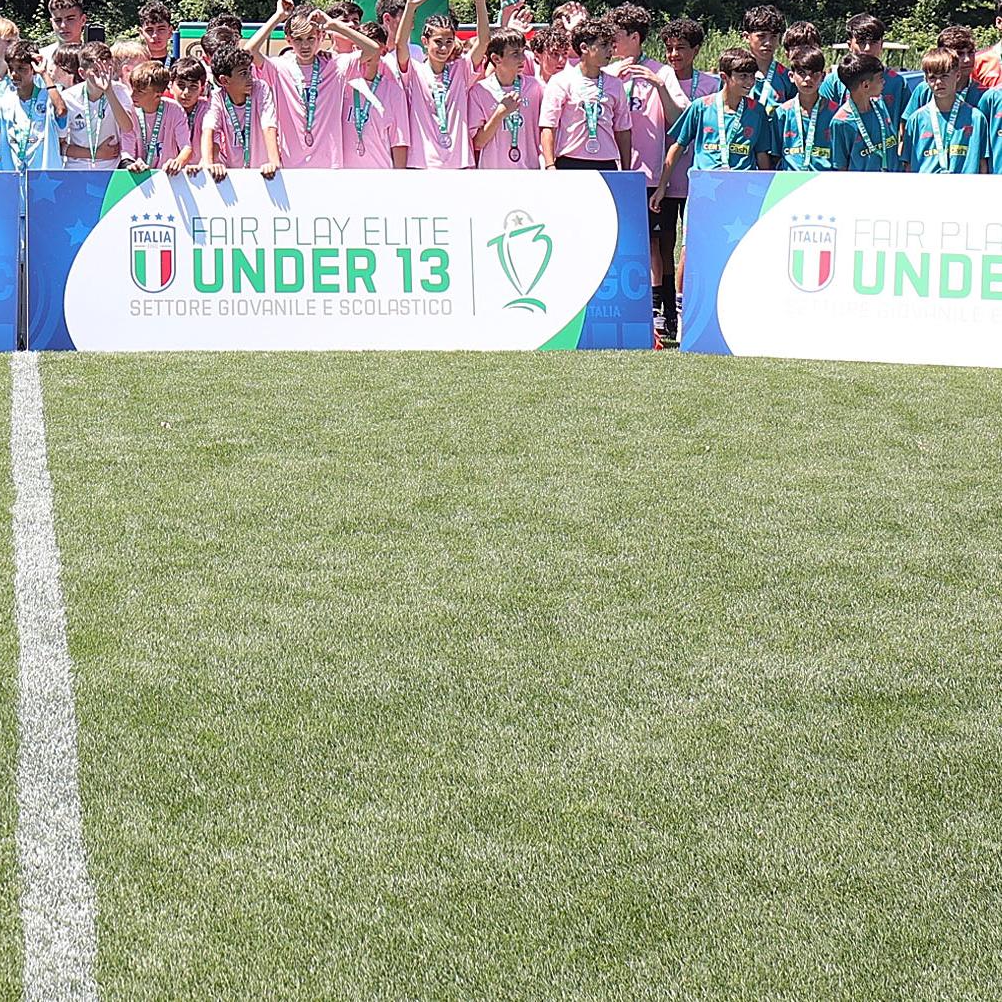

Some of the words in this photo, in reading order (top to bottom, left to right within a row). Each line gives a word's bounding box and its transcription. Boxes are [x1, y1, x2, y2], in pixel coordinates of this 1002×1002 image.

[153, 112, 162, 132] FINALE
[133, 230, 172, 243] ITALIA
[191, 216, 260, 246] FAIR
[273, 216, 351, 246] PLAY
[363, 216, 450, 246] ELITE
[792, 230, 833, 244] ITALIA
[854, 218, 926, 249] FAIR
[192, 248, 378, 294] UNDER
[395, 248, 451, 294] 13
[852, 250, 1002, 301] UNDE
[129, 298, 212, 317] SETTORE
[218, 298, 317, 317] GIOVANILE
[323, 298, 333, 317] E
[339, 298, 453, 317] SCOLASTICO
